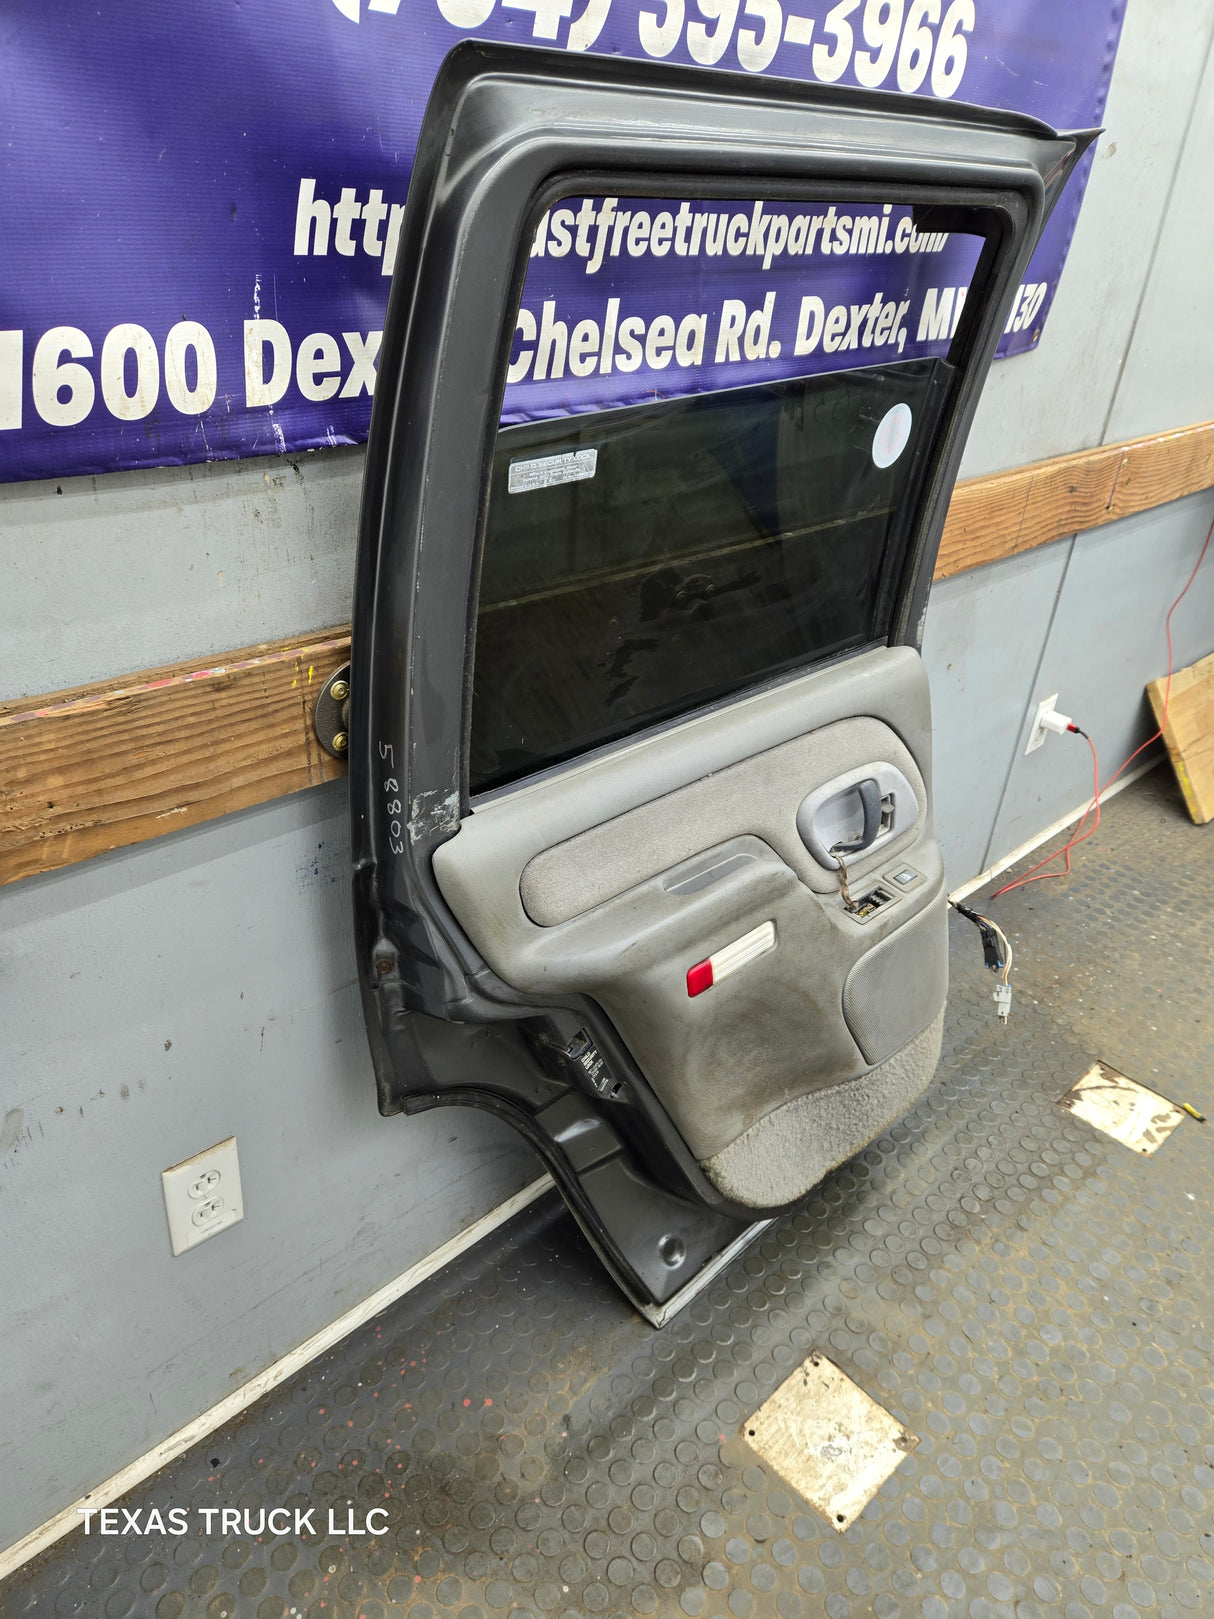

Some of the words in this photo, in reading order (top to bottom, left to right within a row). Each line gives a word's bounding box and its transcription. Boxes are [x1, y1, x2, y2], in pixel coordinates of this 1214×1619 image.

[294, 178, 406, 276] http
[243, 319, 384, 408] Dex
[506, 298, 707, 383] Chelsea
[714, 292, 782, 363] Rd.
[793, 292, 911, 353] Dexter,
[1004, 282, 1047, 334] 130
[379, 741, 404, 855] 58803
